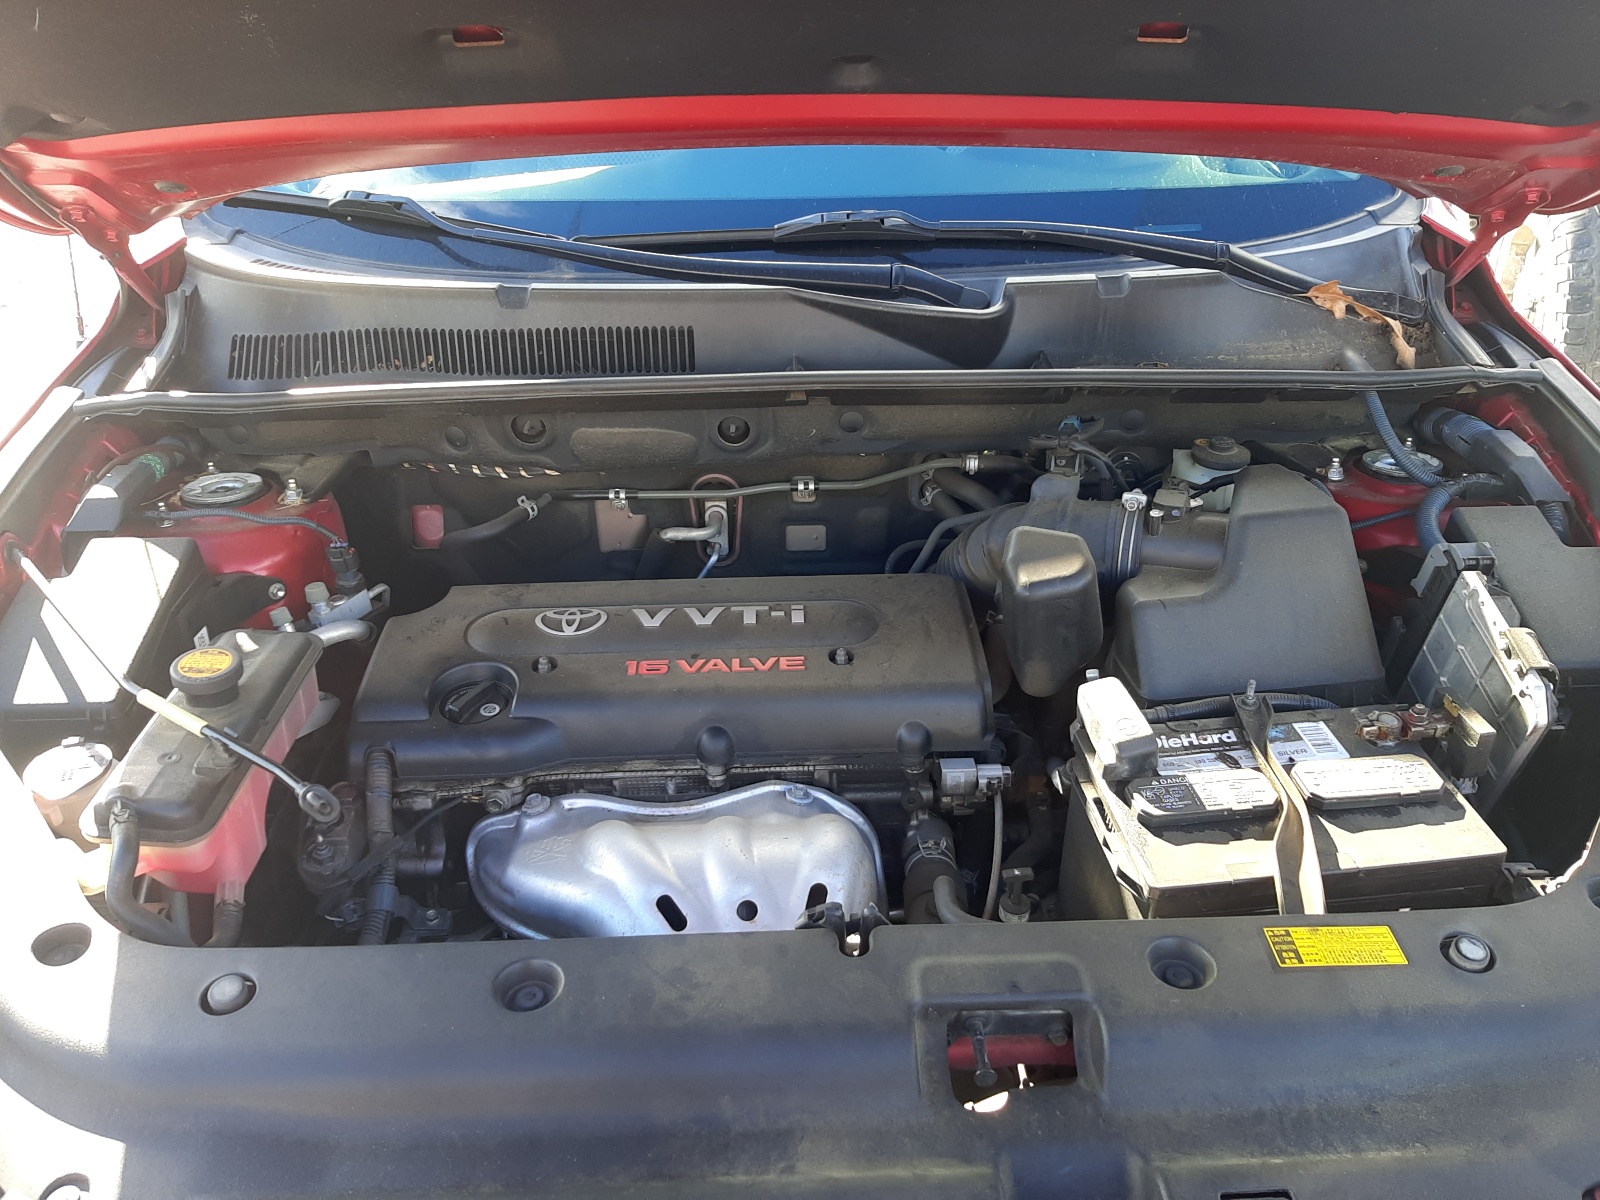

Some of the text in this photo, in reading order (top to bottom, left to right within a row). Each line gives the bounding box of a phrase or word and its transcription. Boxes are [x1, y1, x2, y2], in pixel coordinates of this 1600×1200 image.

[632, 604, 805, 627] VVT-i
[626, 656, 806, 676] 16 VALVE
[1277, 748, 1308, 757] SILVER
[1159, 775, 1189, 785] DANG
